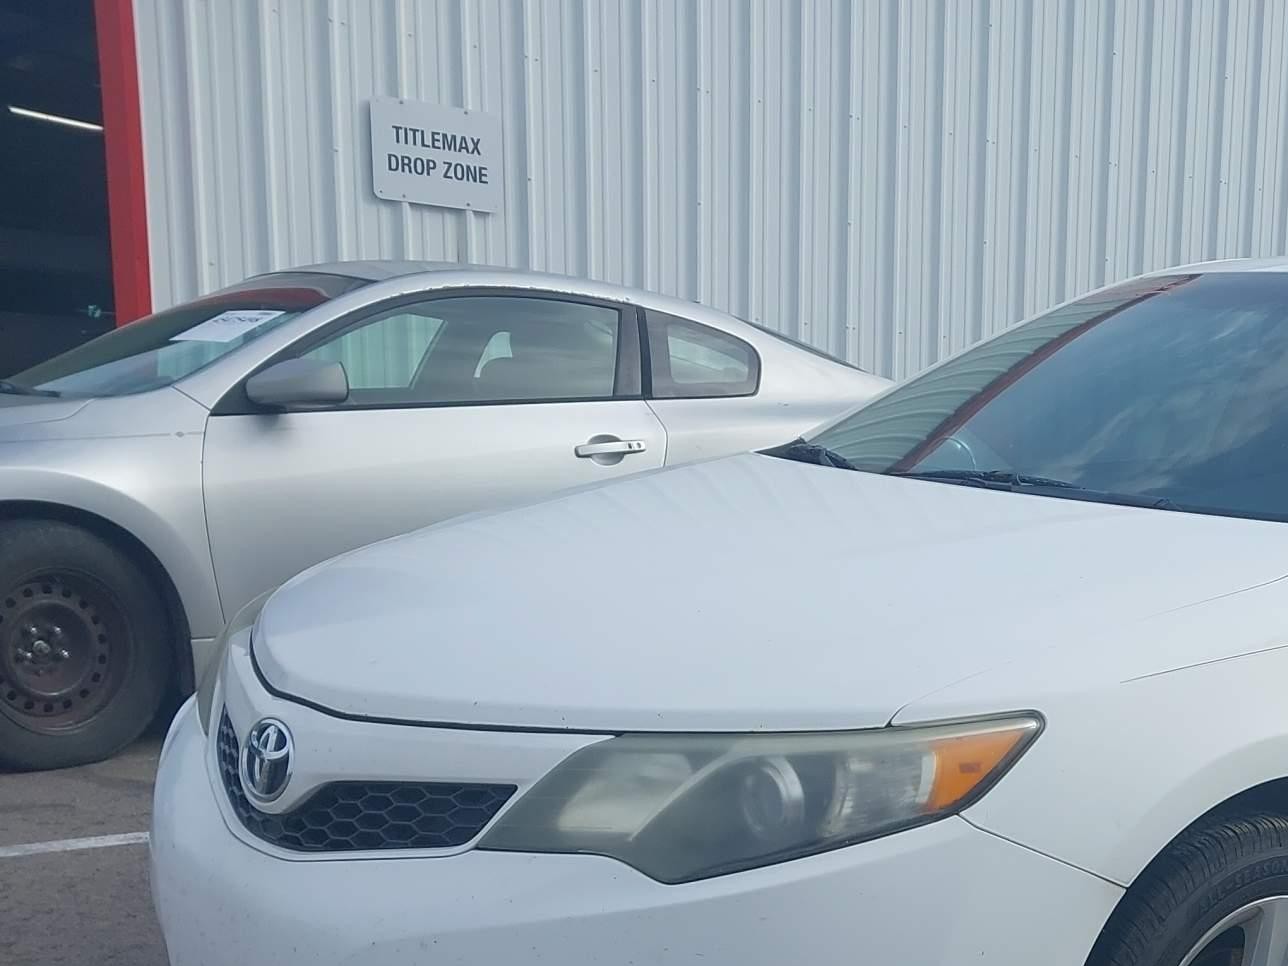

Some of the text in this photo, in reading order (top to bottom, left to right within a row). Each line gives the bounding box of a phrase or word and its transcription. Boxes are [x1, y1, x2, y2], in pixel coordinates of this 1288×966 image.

[392, 125, 481, 156] TITLEMAX
[387, 153, 489, 184] DROP ZONE
